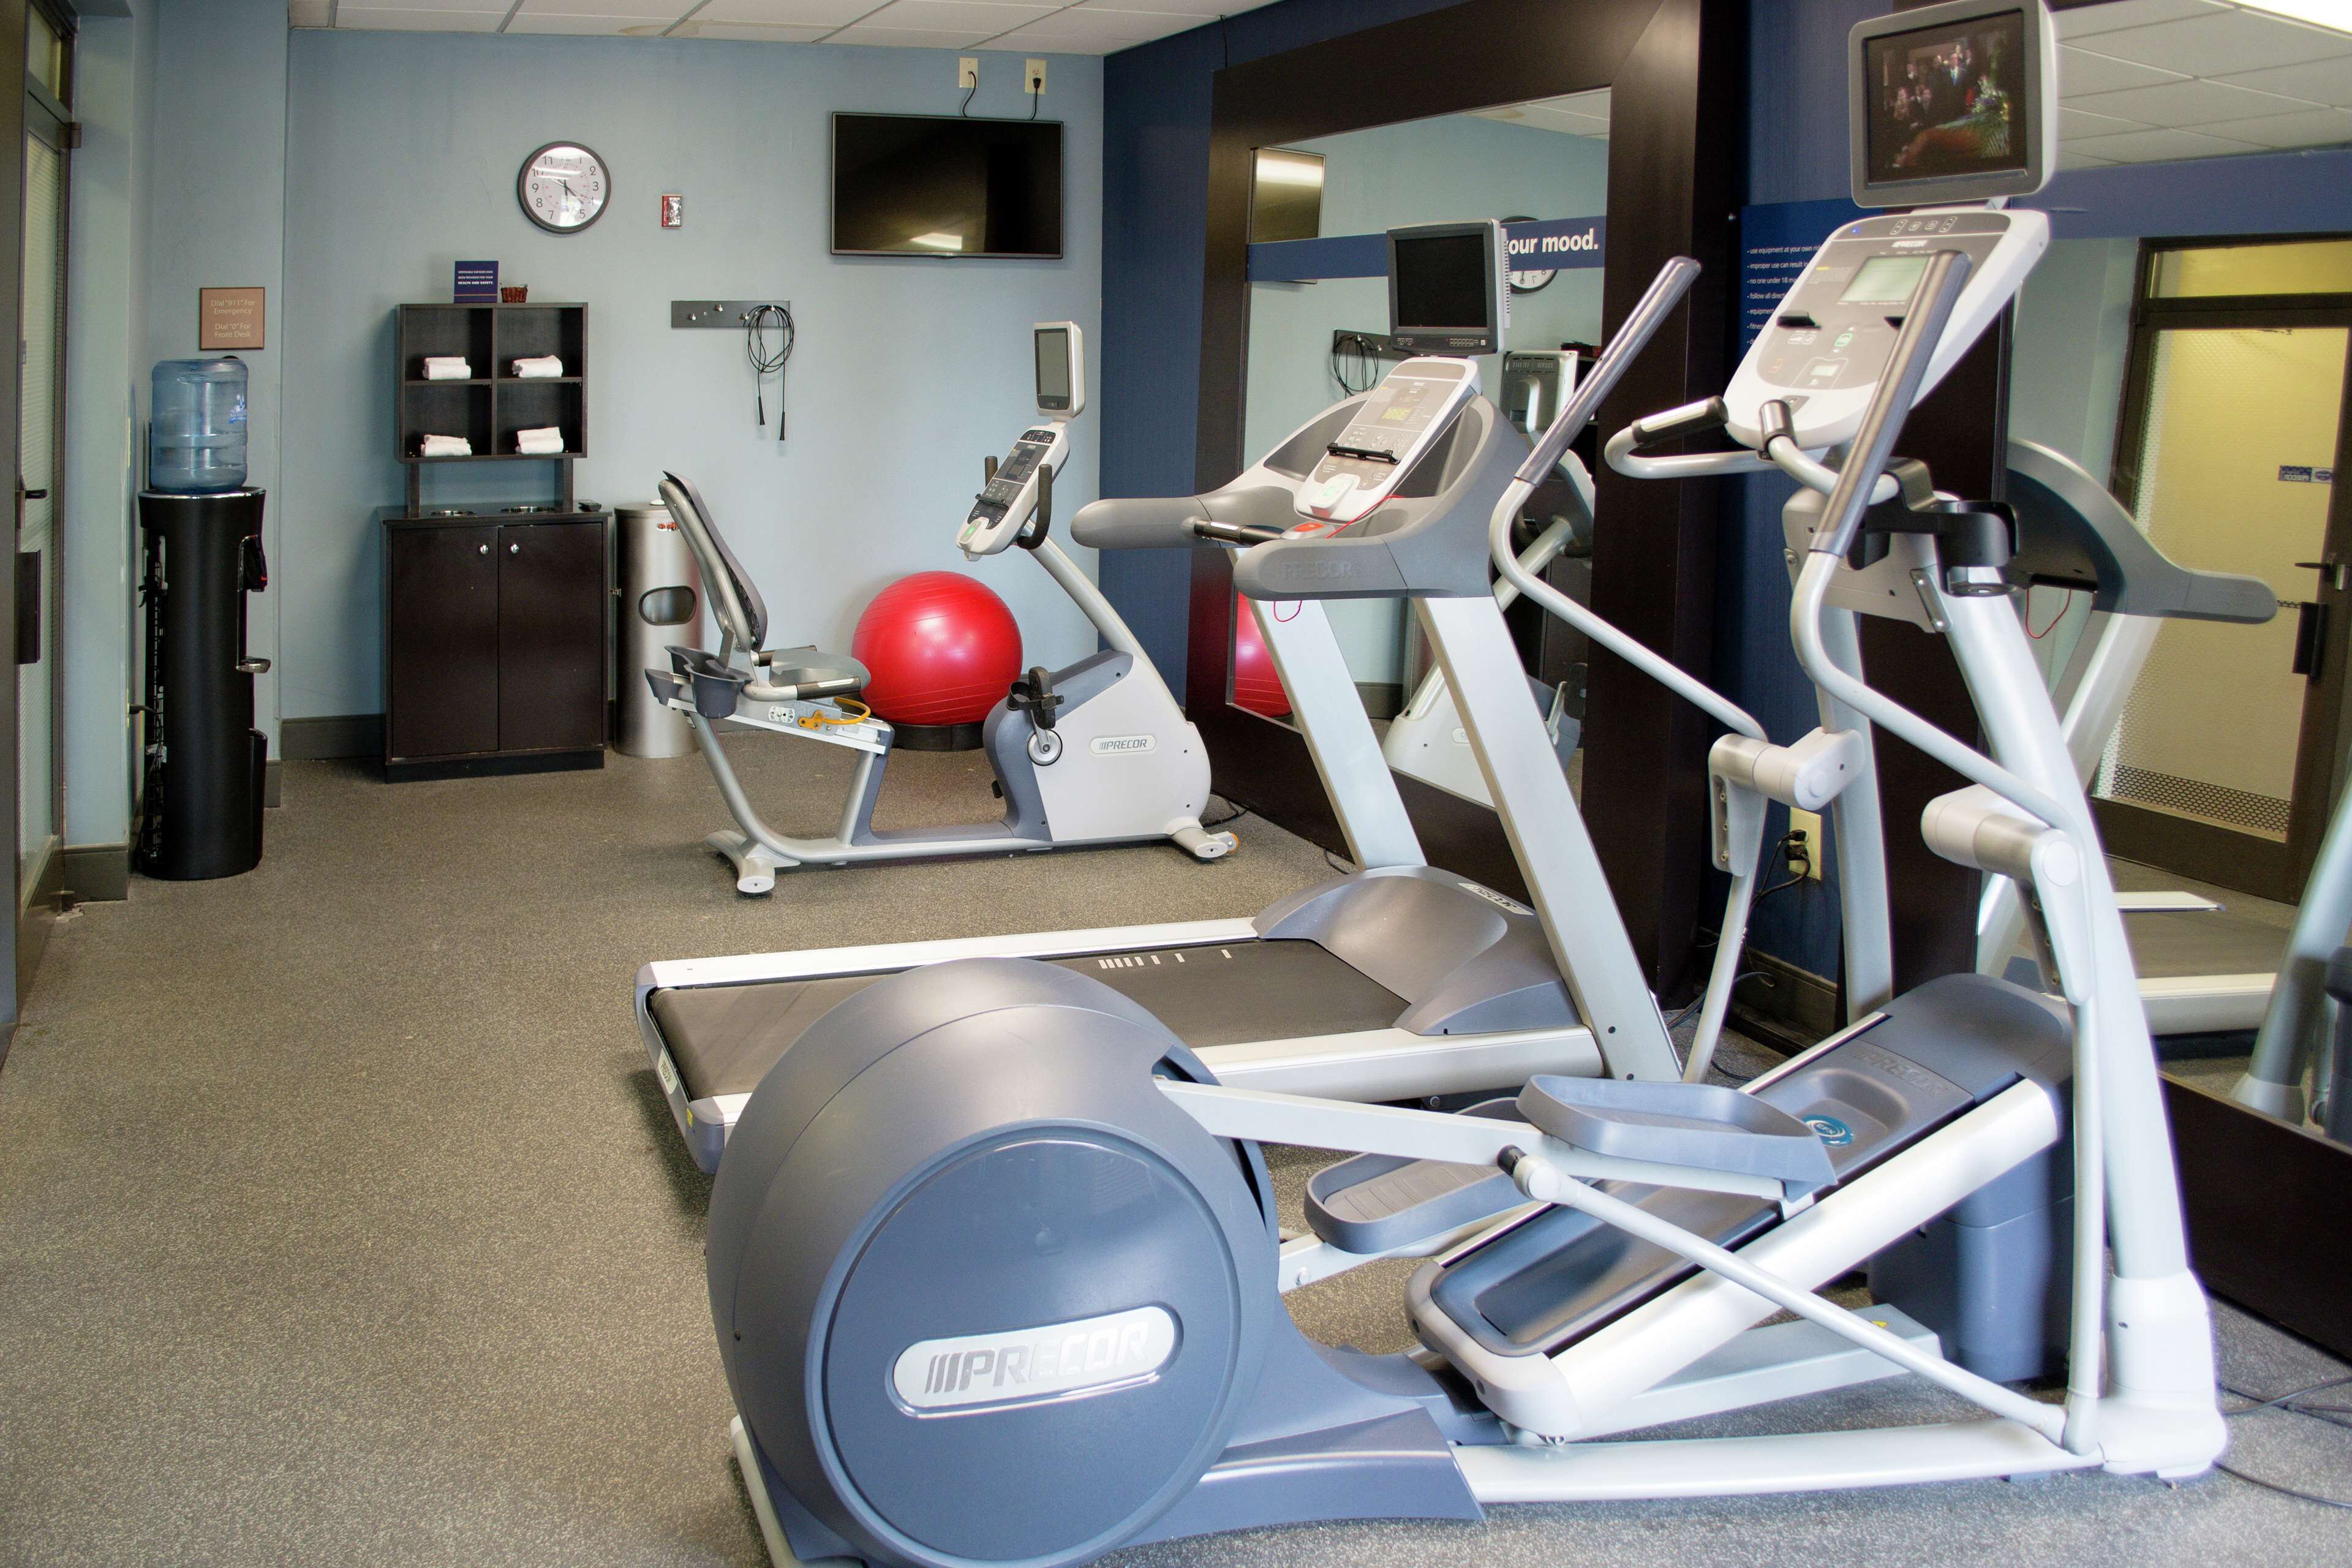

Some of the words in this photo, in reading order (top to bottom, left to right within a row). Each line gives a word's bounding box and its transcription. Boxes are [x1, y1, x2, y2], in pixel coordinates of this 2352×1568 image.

[543, 156, 552, 165] 11
[589, 166, 596, 176] 2
[532, 183, 539, 193] 9
[592, 181, 599, 191] 3
[536, 198, 543, 208] 8
[548, 211, 554, 220] 7
[579, 209, 586, 219] 5
[1506, 238, 1538, 255] our
[1542, 227, 1598, 253] mood.
[1106, 739, 1147, 750] PRECOR
[1816, 1123, 1836, 1135] EFX
[958, 1321, 1148, 1392] PRECOR
